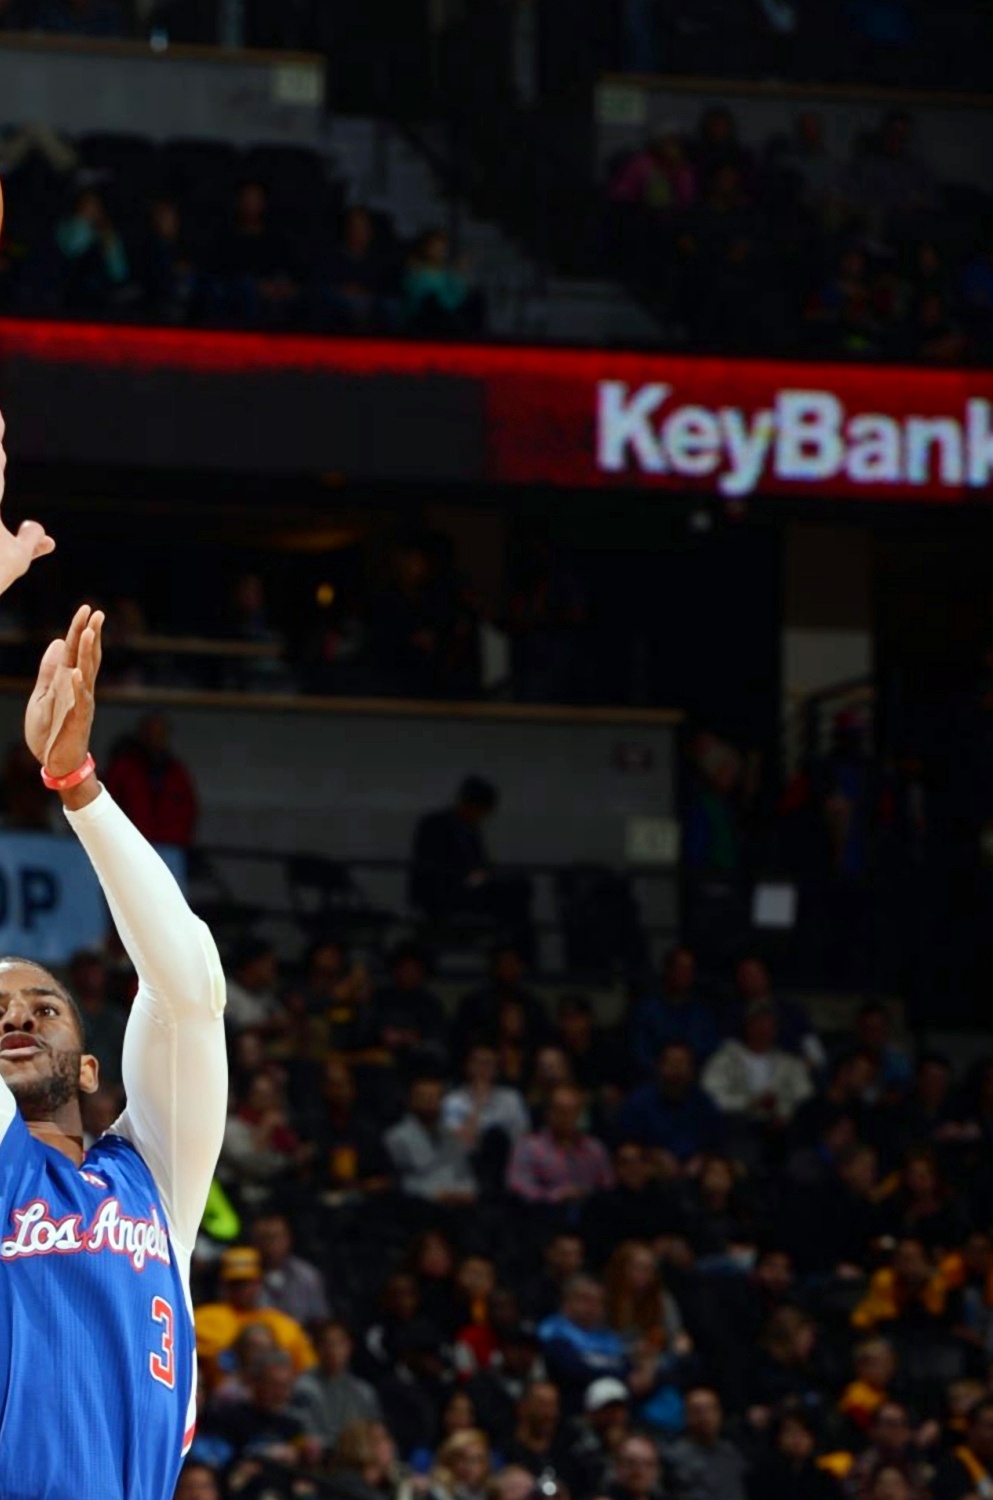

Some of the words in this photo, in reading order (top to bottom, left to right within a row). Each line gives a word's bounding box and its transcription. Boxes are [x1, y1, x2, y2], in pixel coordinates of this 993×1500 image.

[0, 1197, 84, 1262] Los
[88, 1196, 171, 1273] Angel
[149, 1295, 175, 1390] 3
